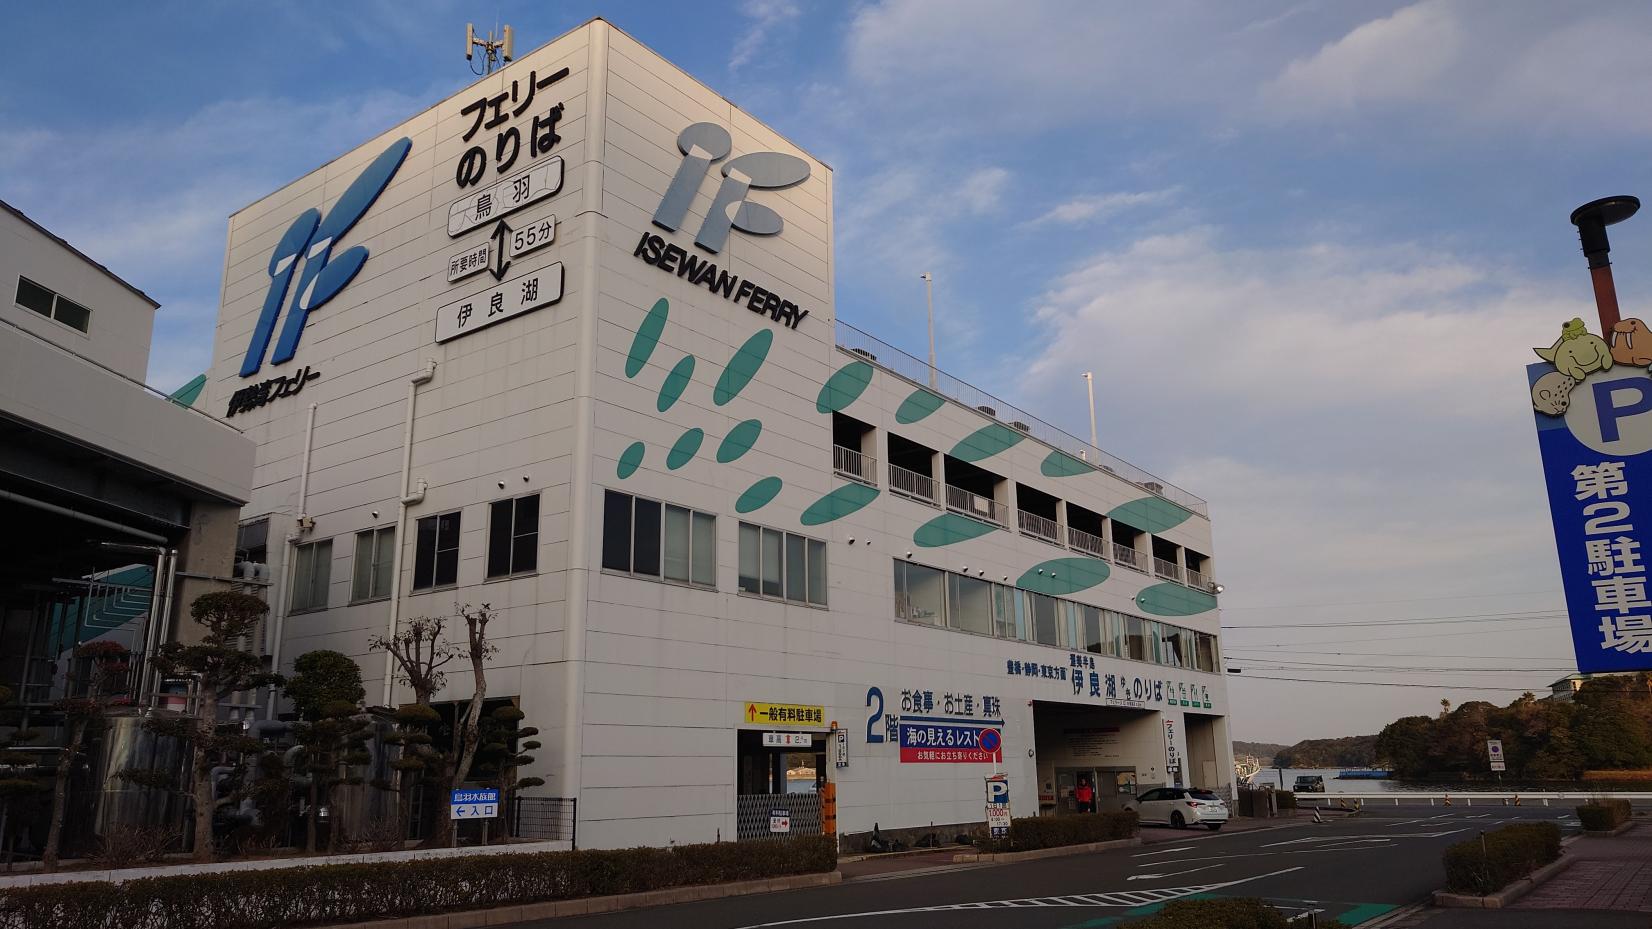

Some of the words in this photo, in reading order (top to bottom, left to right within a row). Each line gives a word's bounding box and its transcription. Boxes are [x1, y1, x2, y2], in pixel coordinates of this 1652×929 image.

[461, 67, 569, 142] フェリー
[456, 102, 564, 188] のりば
[475, 174, 530, 221] 鳥羽
[515, 221, 552, 250] 55分
[450, 248, 487, 276] 所要時間
[634, 232, 738, 299] ISEWAN
[734, 279, 809, 330] FERRY
[457, 277, 539, 328] 伊良湖
[1592, 376, 1652, 443] P
[1570, 461, 1652, 653] 第2駐車場
[759, 706, 822, 723] 一般有料駐車場
[907, 727, 979, 746] 海の見えるレスト
[917, 751, 989, 761] お気軽にお立ち寄りください
[471, 805, 493, 816] 入口
[987, 781, 1008, 802] P
